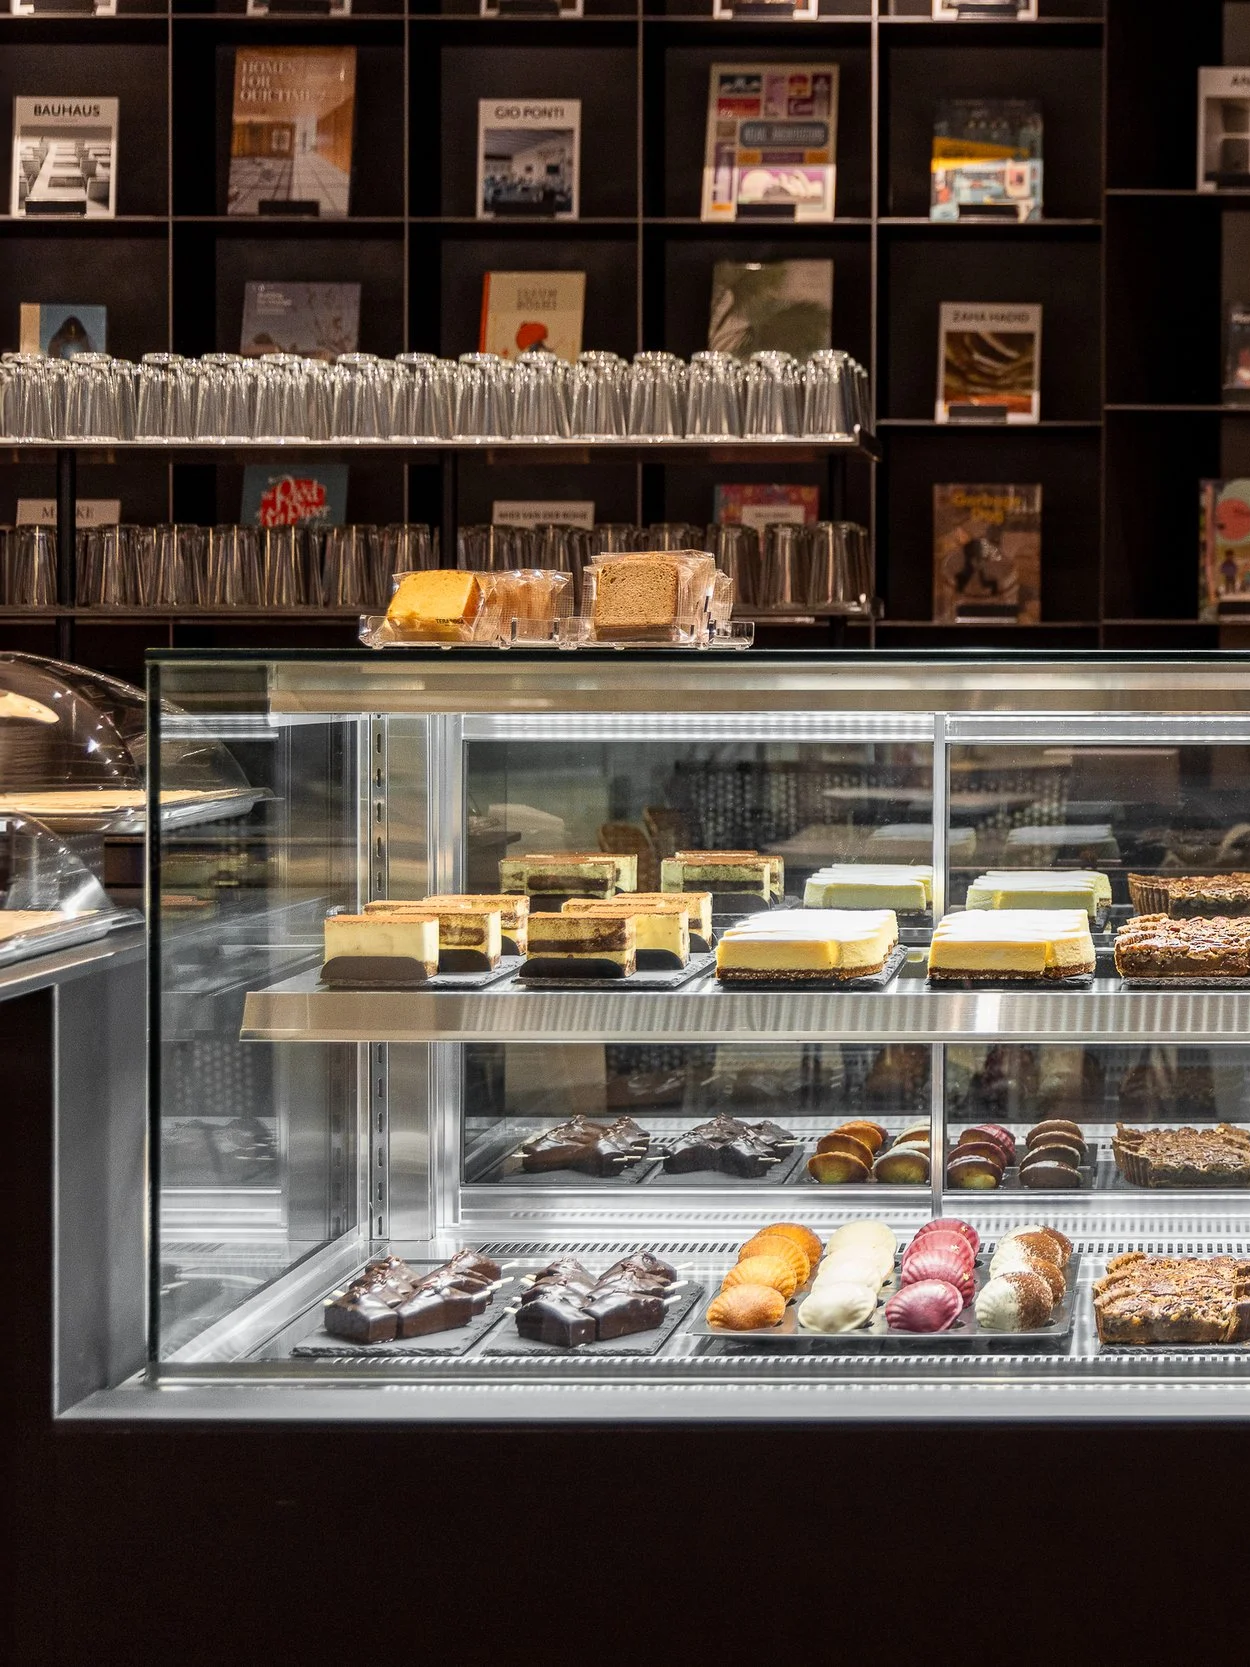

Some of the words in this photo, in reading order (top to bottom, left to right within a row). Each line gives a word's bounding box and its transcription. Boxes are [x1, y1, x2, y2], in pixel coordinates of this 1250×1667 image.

[33, 104, 100, 117] BAUHAUS
[494, 105, 521, 119] GIO
[523, 106, 564, 118] PONTI
[952, 310, 986, 322] ZAHA
